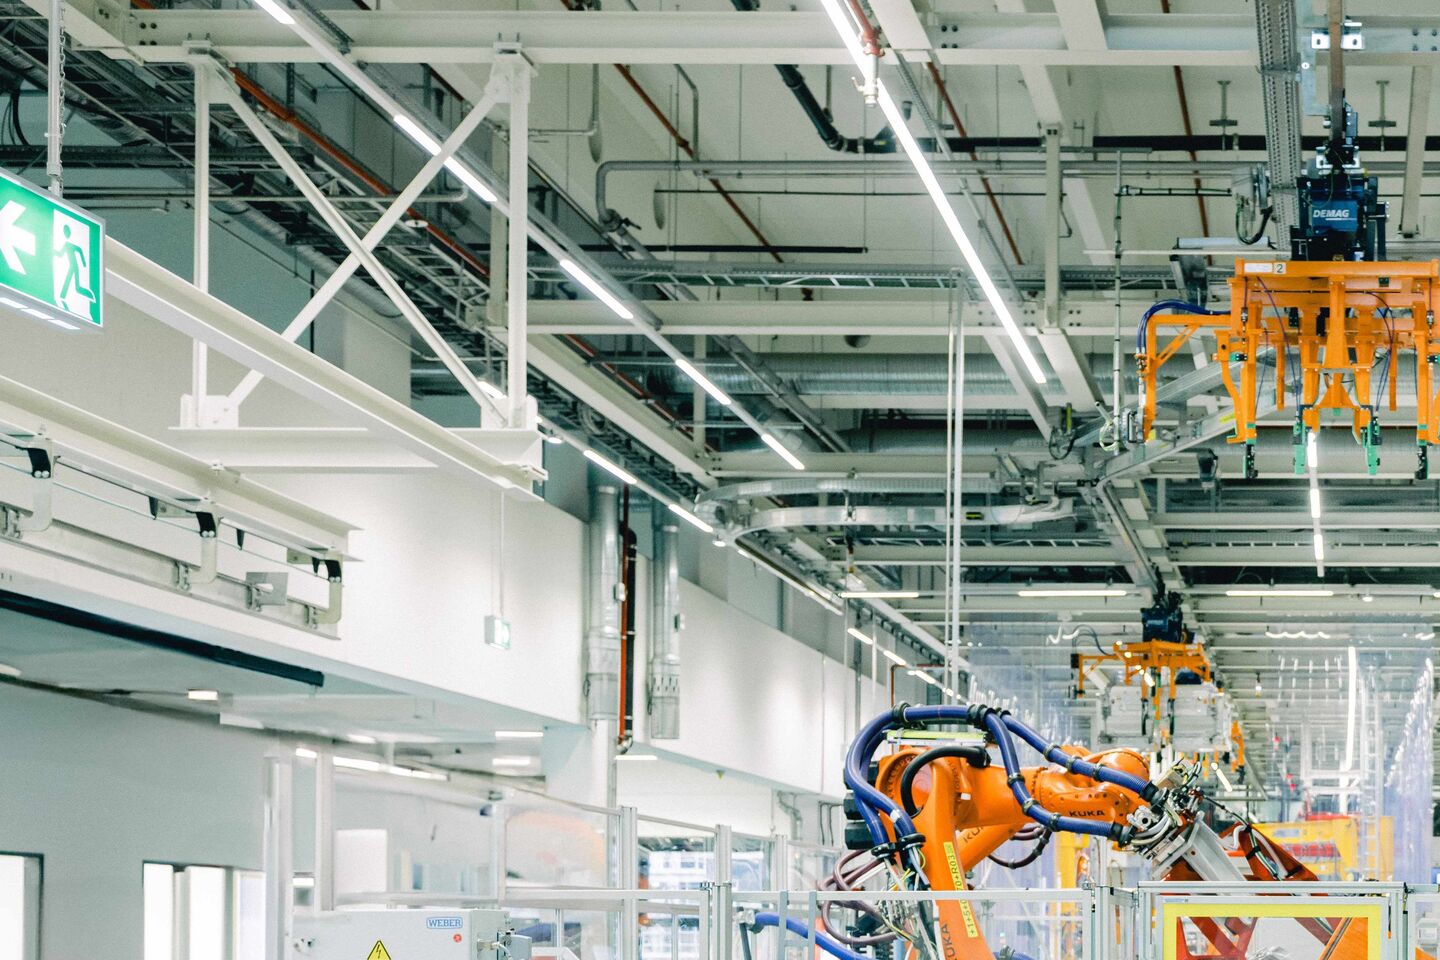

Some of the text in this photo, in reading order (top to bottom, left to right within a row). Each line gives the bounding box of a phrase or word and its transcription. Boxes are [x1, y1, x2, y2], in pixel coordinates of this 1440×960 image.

[1313, 209, 1349, 218] DEMAG
[1276, 264, 1283, 274] 2
[429, 919, 461, 927] WEBER
